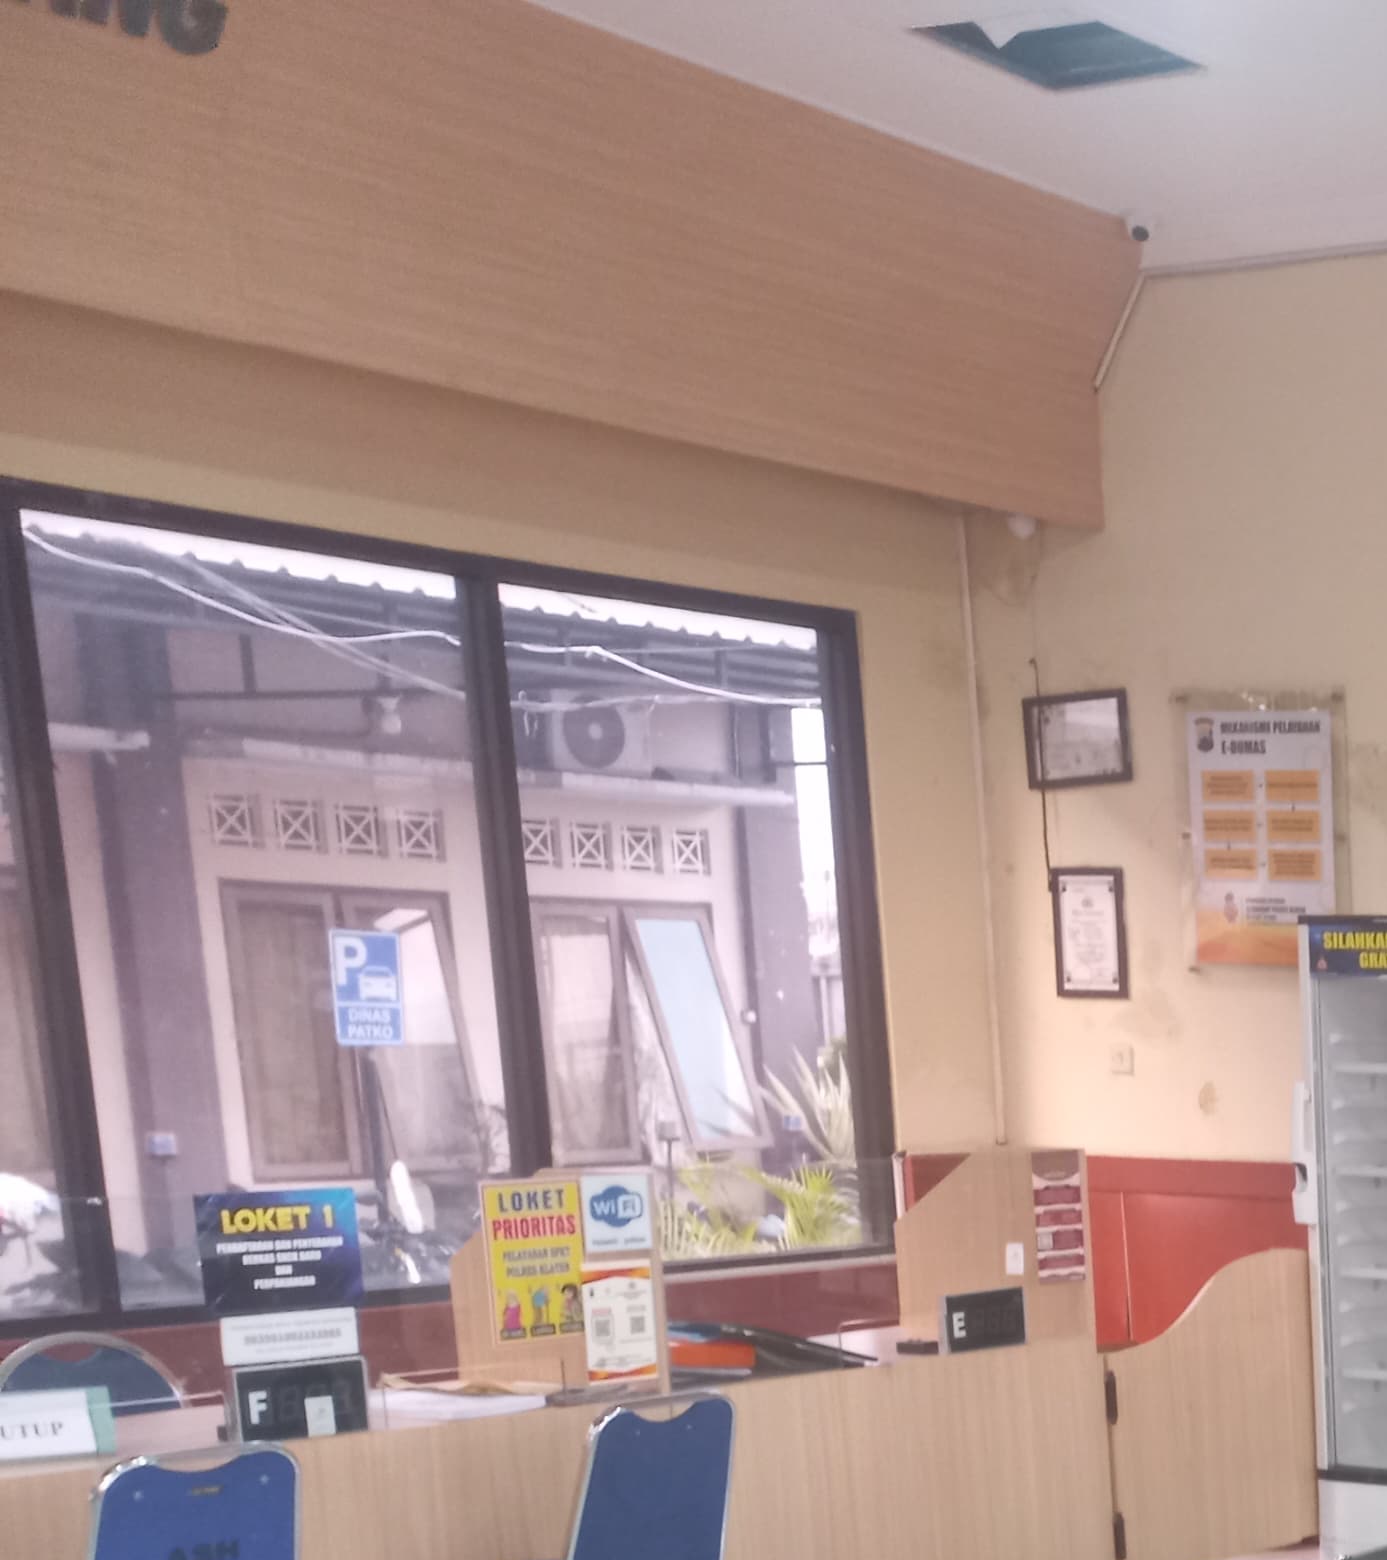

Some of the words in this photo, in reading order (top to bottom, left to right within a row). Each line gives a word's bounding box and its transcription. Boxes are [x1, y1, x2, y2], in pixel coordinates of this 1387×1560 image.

[334, 937, 367, 986] P
[498, 1189, 564, 1213] LOKET
[220, 1205, 311, 1234] LOKET
[492, 1215, 576, 1241] PRIORITAS
[952, 1311, 966, 1338] E
[248, 1390, 267, 1425] F
[0, 1420, 65, 1441] UTUP
